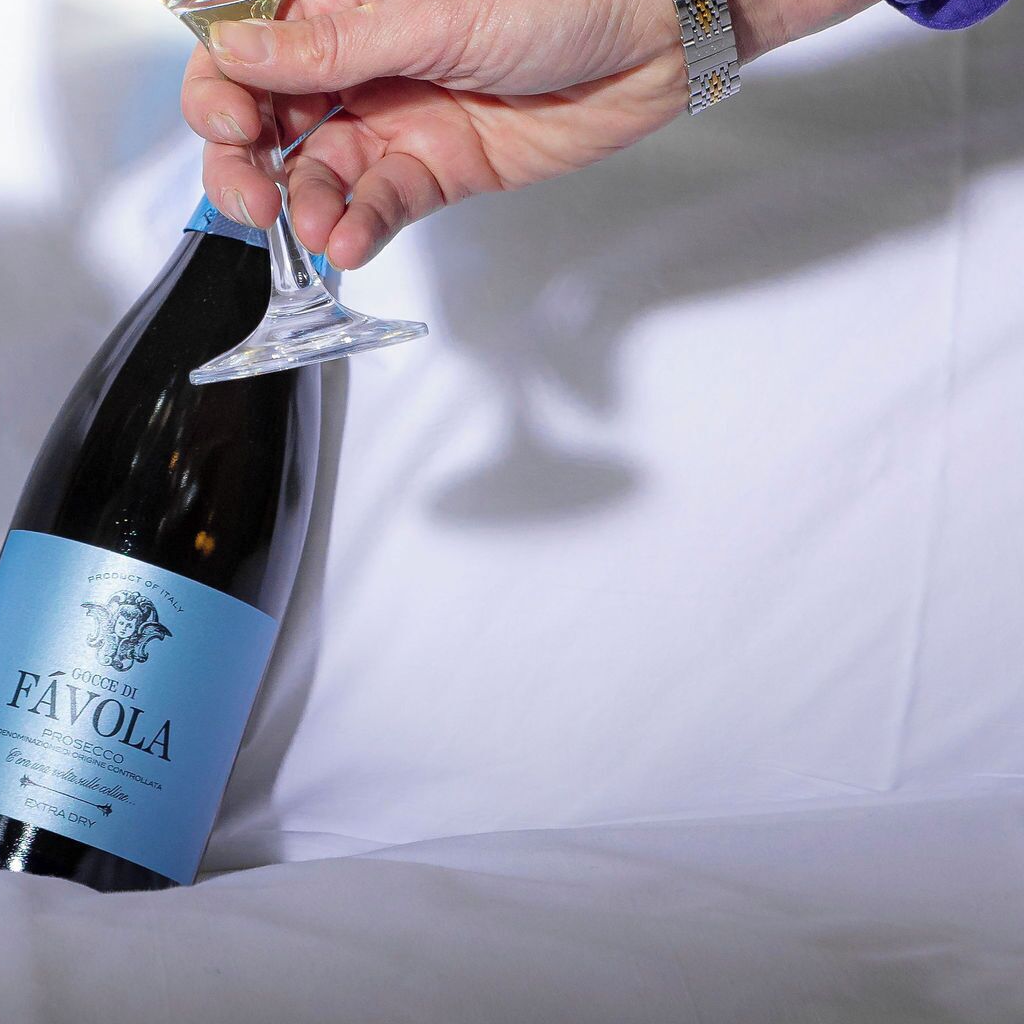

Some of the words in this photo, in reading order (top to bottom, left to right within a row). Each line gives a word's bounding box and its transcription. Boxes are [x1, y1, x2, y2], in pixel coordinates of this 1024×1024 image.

[88, 572, 142, 583] PRODUCT
[144, 580, 160, 590] OF
[160, 589, 184, 613] ITALY
[72, 667, 119, 693] GOCCE
[121, 684, 138, 700] DI
[6, 669, 172, 762] FÁVOLA
[41, 728, 125, 764] PROSECCO
[71, 752, 106, 769] ORIGINE
[107, 764, 163, 791] CONTROLLATA
[25, 798, 66, 817] EXTRA
[68, 811, 96, 828] DRY
